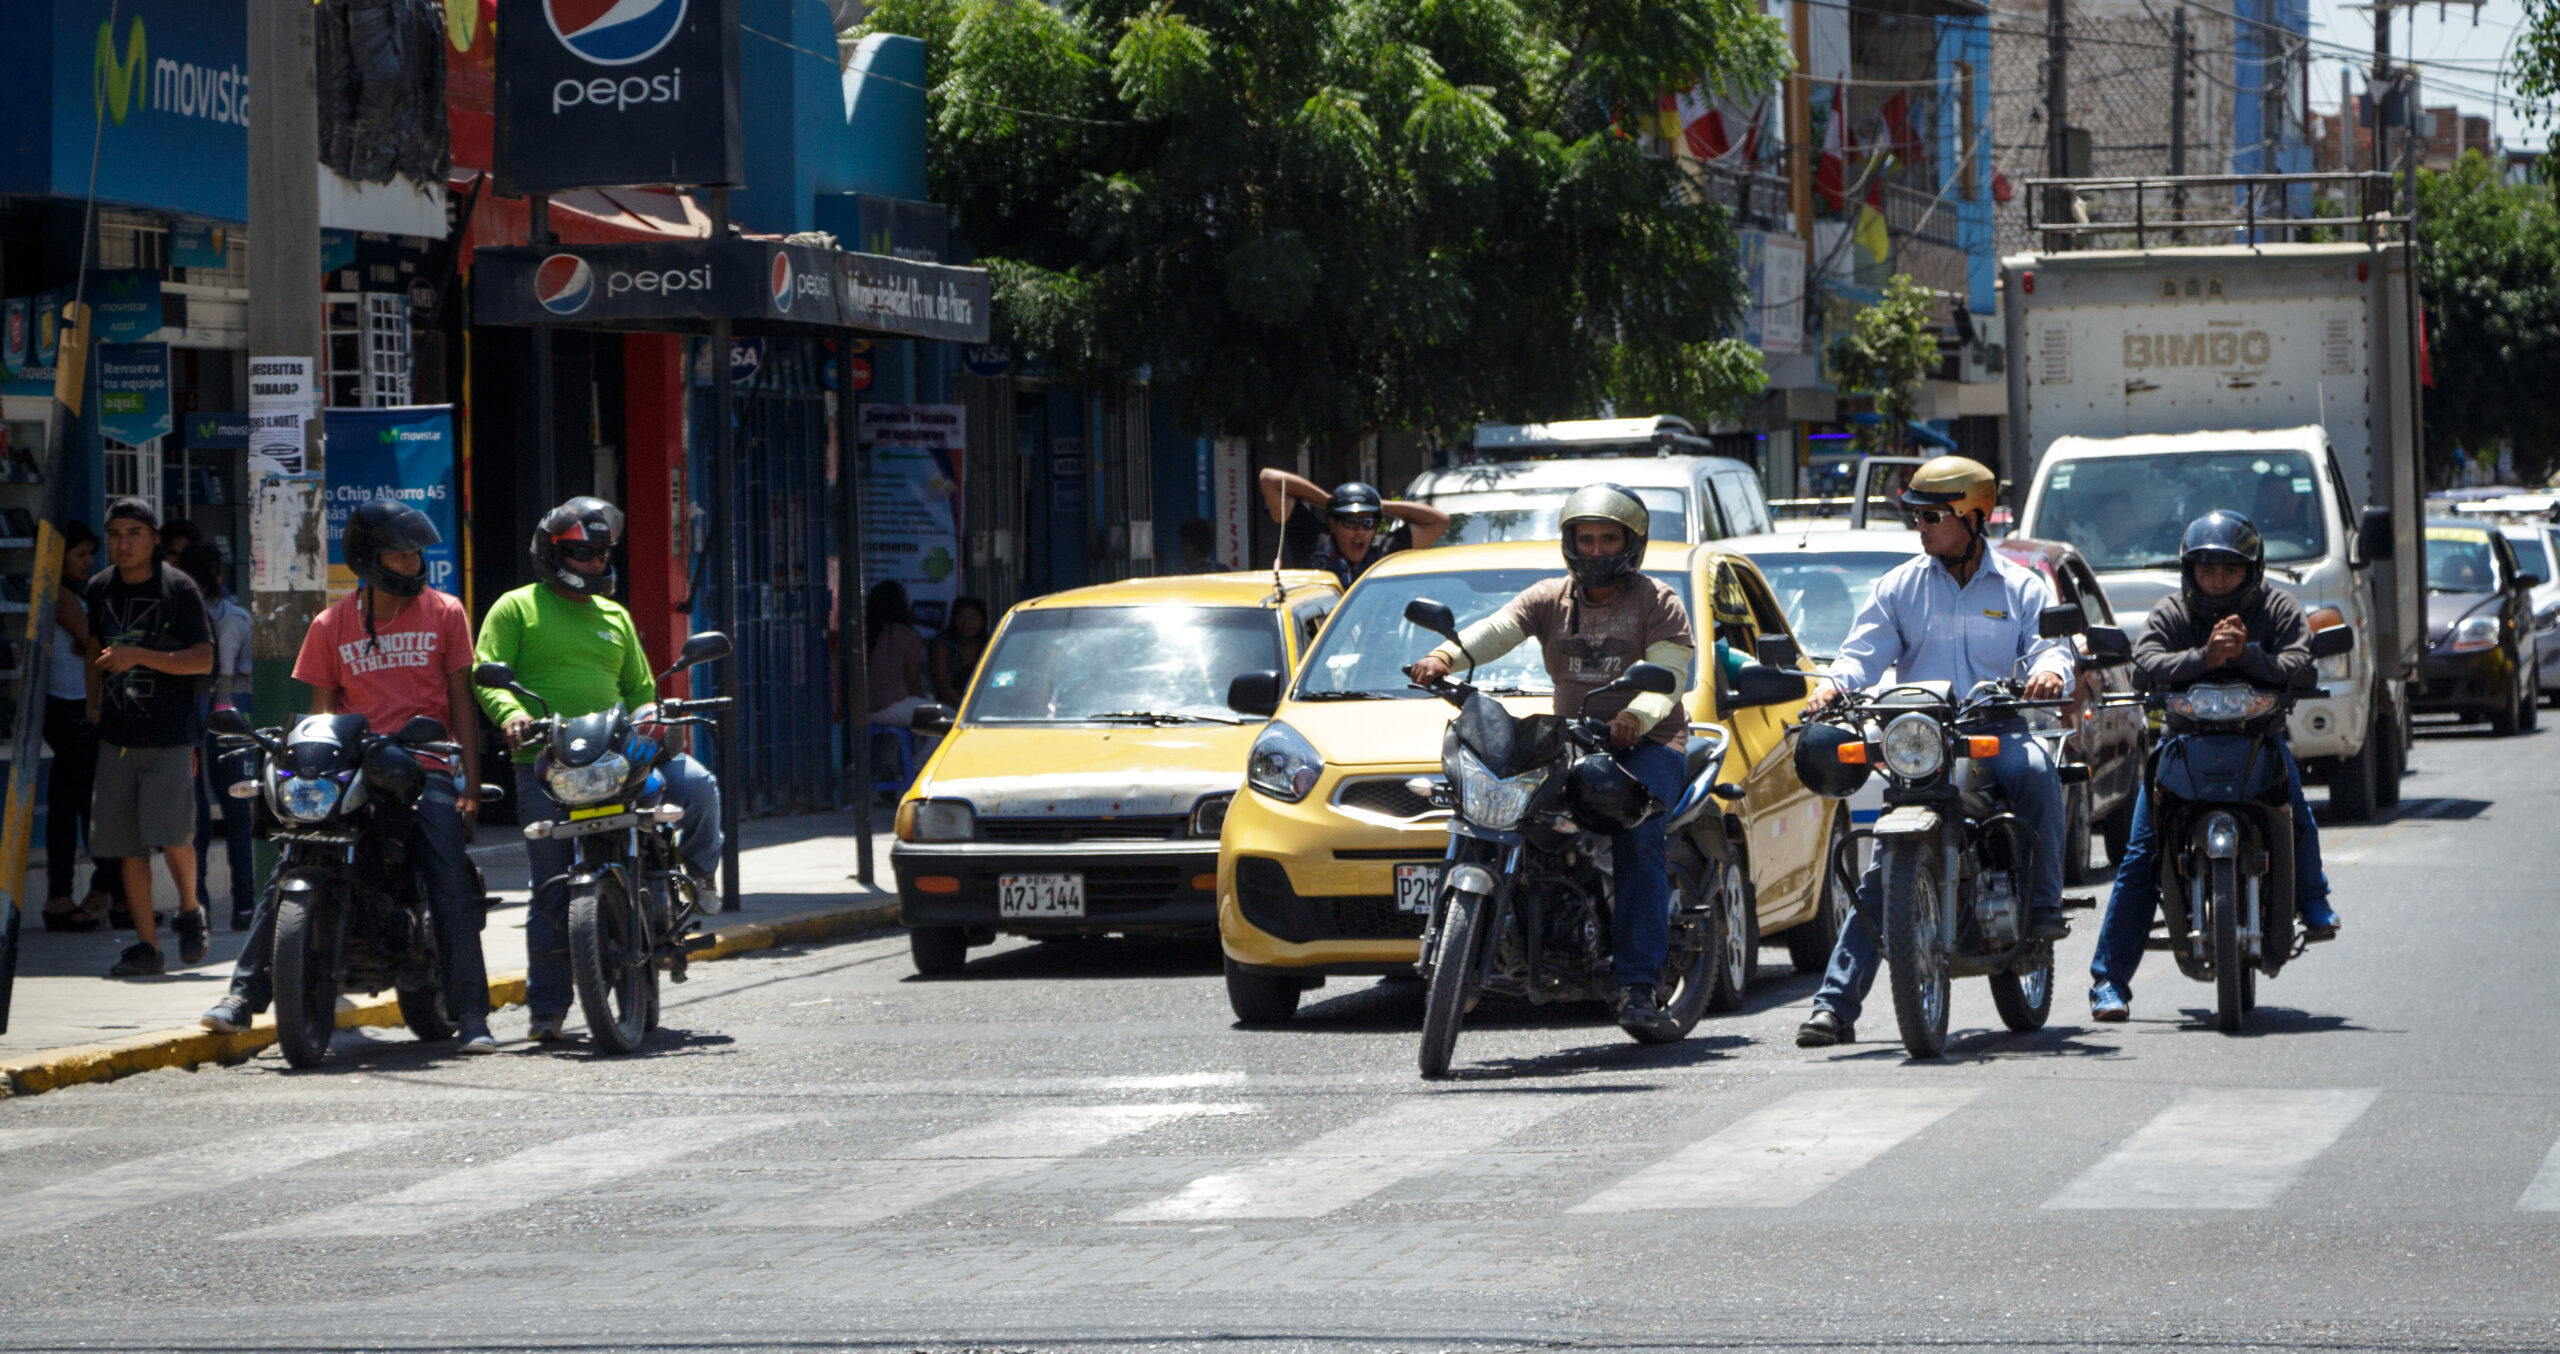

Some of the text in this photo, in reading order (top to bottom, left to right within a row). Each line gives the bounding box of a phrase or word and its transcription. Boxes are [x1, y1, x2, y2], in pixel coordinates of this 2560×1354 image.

[153, 57, 249, 127] movista
[553, 67, 681, 114] pepsi
[608, 264, 712, 298] pepsi
[797, 272, 830, 300] pepsi
[730, 346, 759, 366] SA
[2123, 330, 2270, 367] BIMBO
[103, 362, 160, 375] Renueva
[103, 378, 165, 393] tu equipo
[400, 430, 442, 442] movistar
[337, 485, 372, 502] Chip
[374, 484, 426, 501] Ahorro
[427, 484, 447, 500] 45
[350, 651, 429, 677] ATHLETICS
[1568, 656, 1622, 673] 19 72
[1026, 877, 1056, 887] PERU
